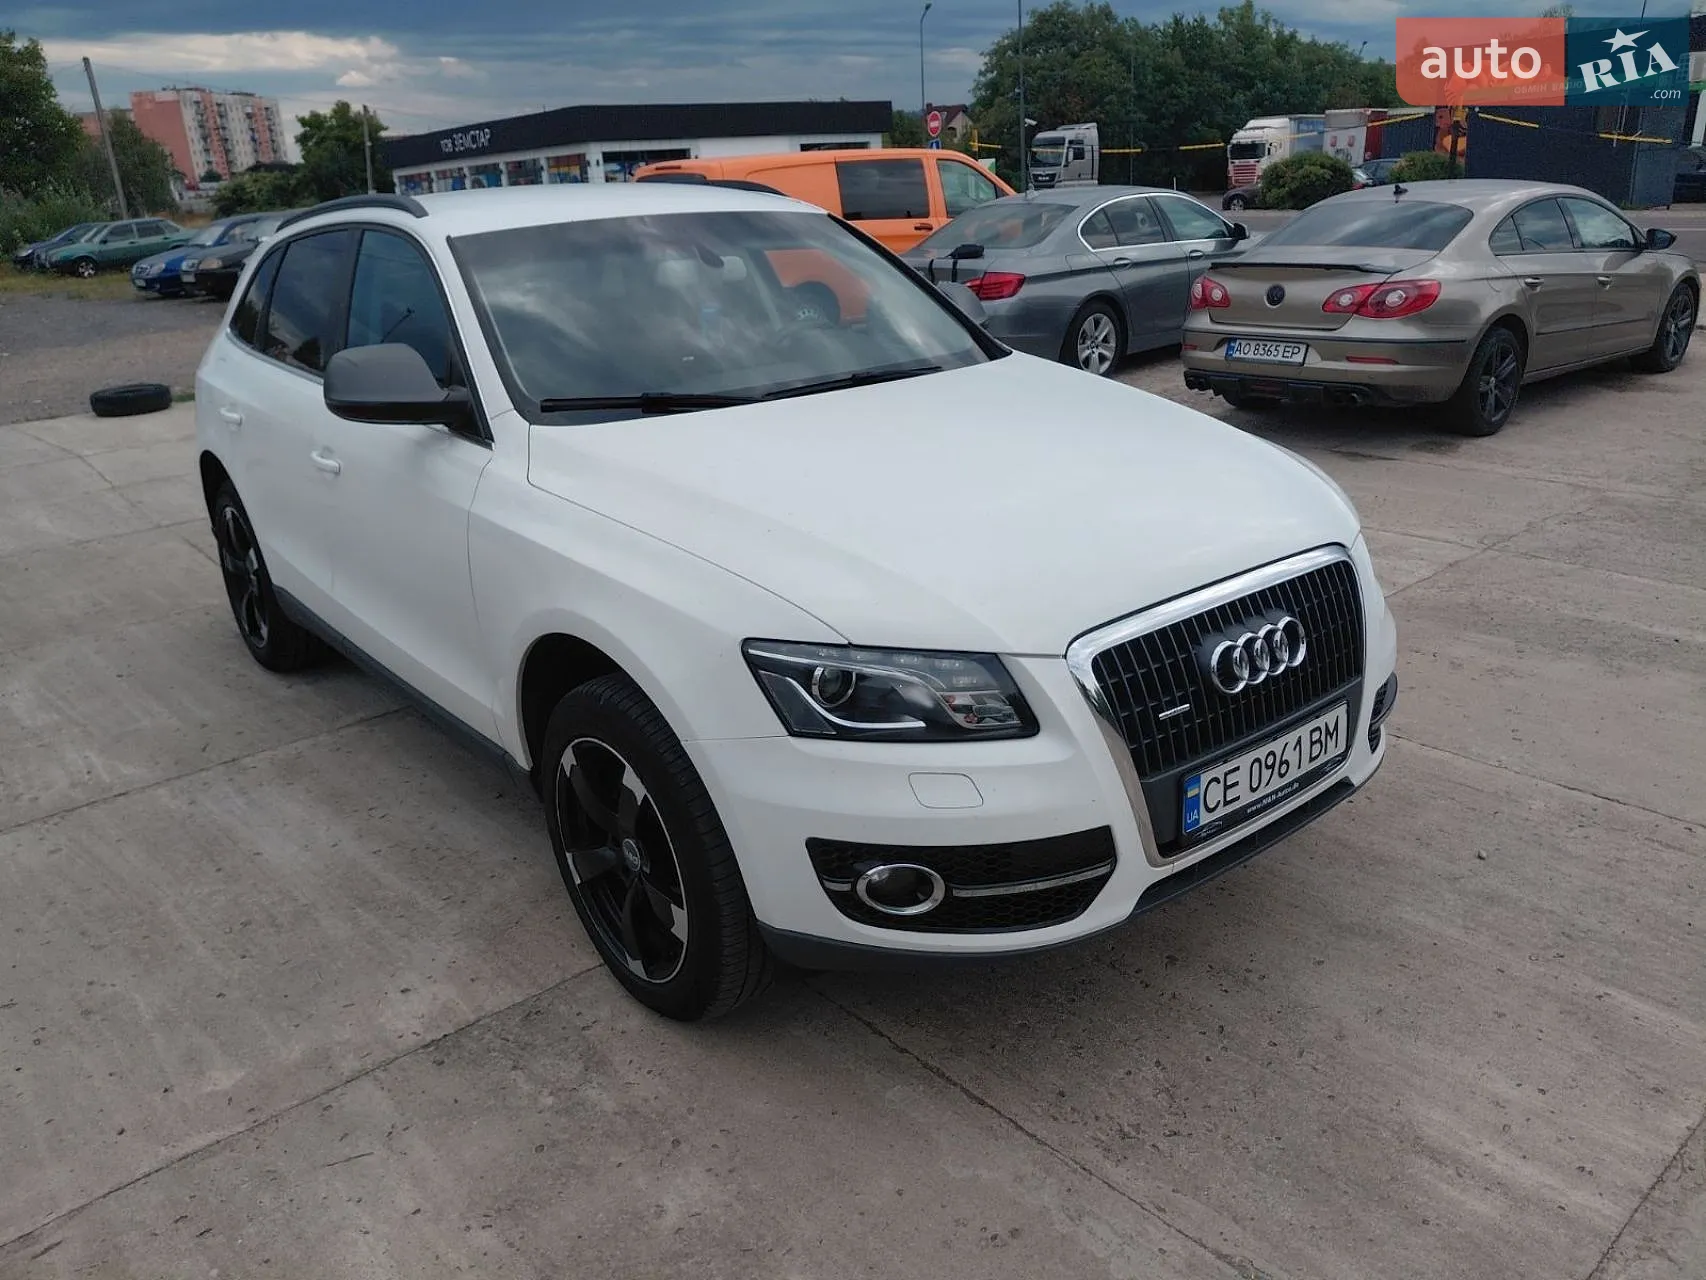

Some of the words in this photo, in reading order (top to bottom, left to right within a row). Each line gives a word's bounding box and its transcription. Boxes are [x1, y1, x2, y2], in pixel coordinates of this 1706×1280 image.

[1235, 342, 1252, 355] AO
[1253, 343, 1280, 357] 8365
[1282, 345, 1301, 359] EP
[1203, 767, 1241, 813] CE
[1250, 735, 1303, 793] 0961
[1308, 716, 1339, 763] BM
[1186, 810, 1199, 823] UA
